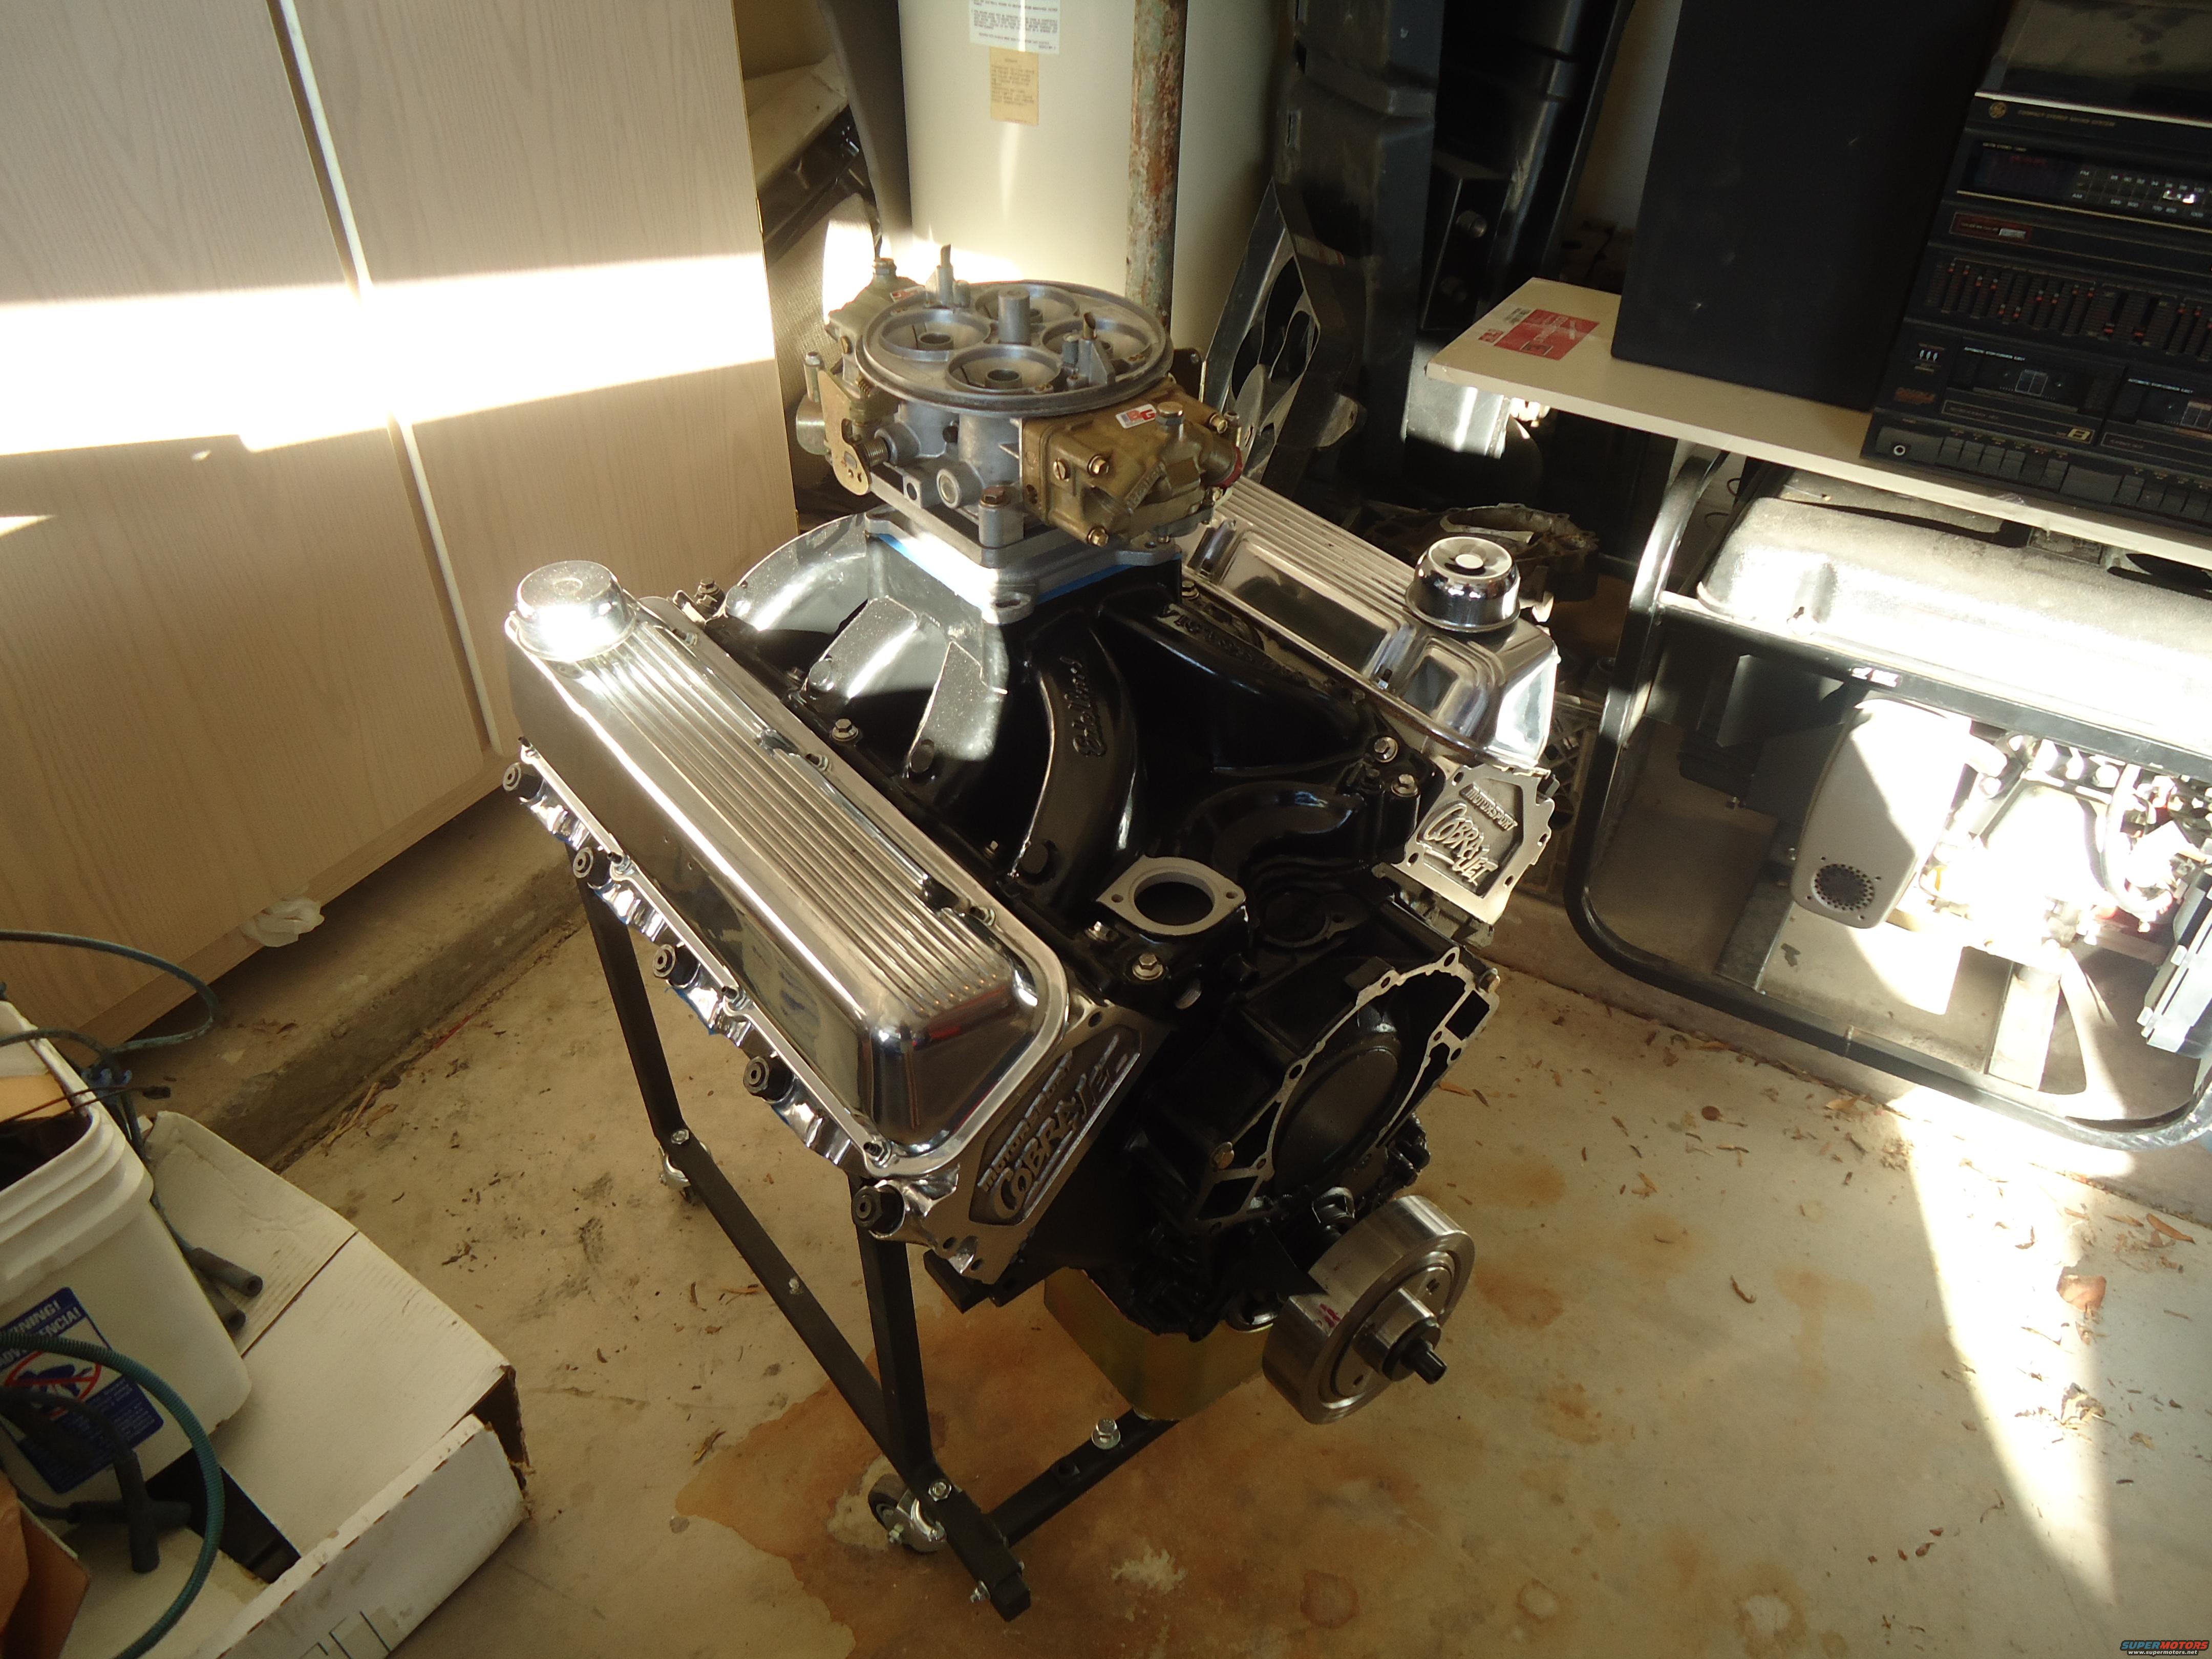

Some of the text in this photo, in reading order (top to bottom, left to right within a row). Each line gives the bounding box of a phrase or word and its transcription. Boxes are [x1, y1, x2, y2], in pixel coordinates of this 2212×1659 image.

[1423, 803, 1499, 886] COBRA JET
[1465, 782, 1518, 832] MOTORSPORT
[992, 1096, 1077, 1220] COBRA
